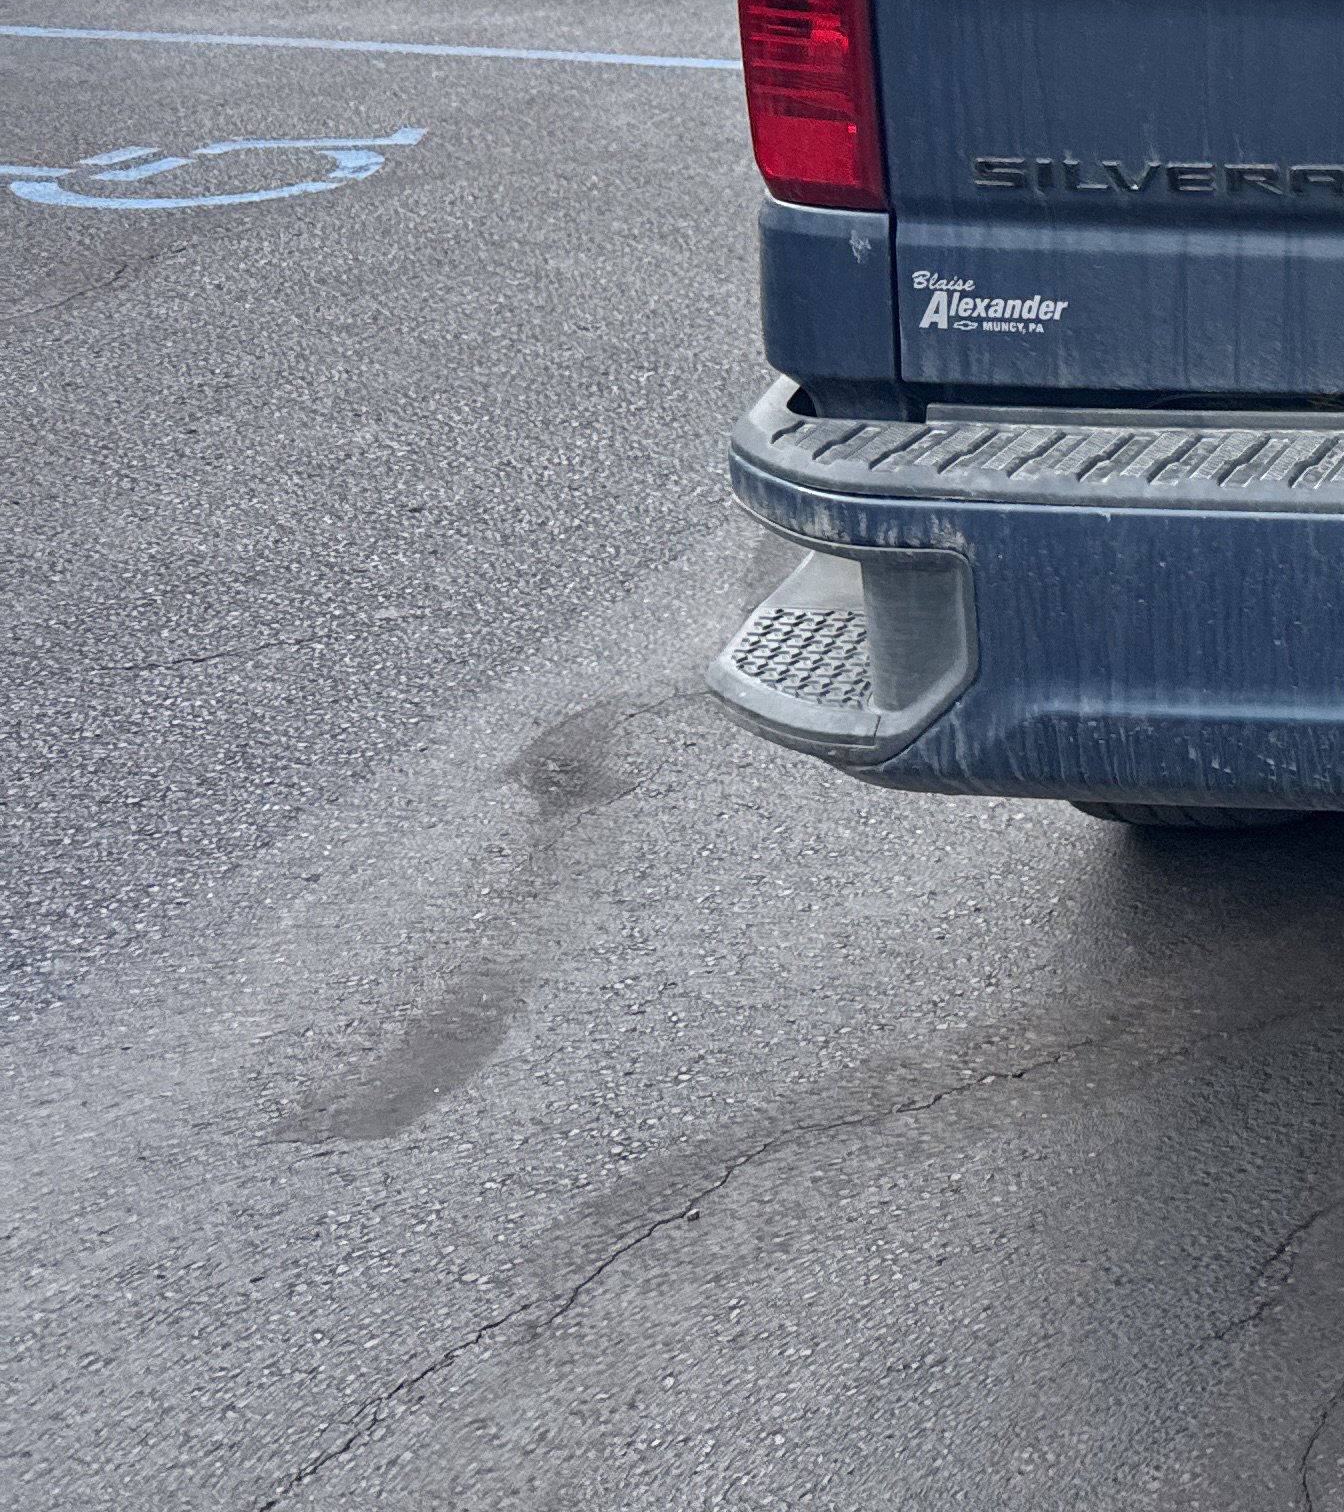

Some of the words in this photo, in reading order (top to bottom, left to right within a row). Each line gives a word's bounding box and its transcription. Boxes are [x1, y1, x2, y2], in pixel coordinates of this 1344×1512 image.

[911, 270, 975, 291] Blaise
[918, 290, 1069, 329] Alexander
[982, 321, 1026, 334] MUNCY,
[1028, 323, 1045, 333] PA
